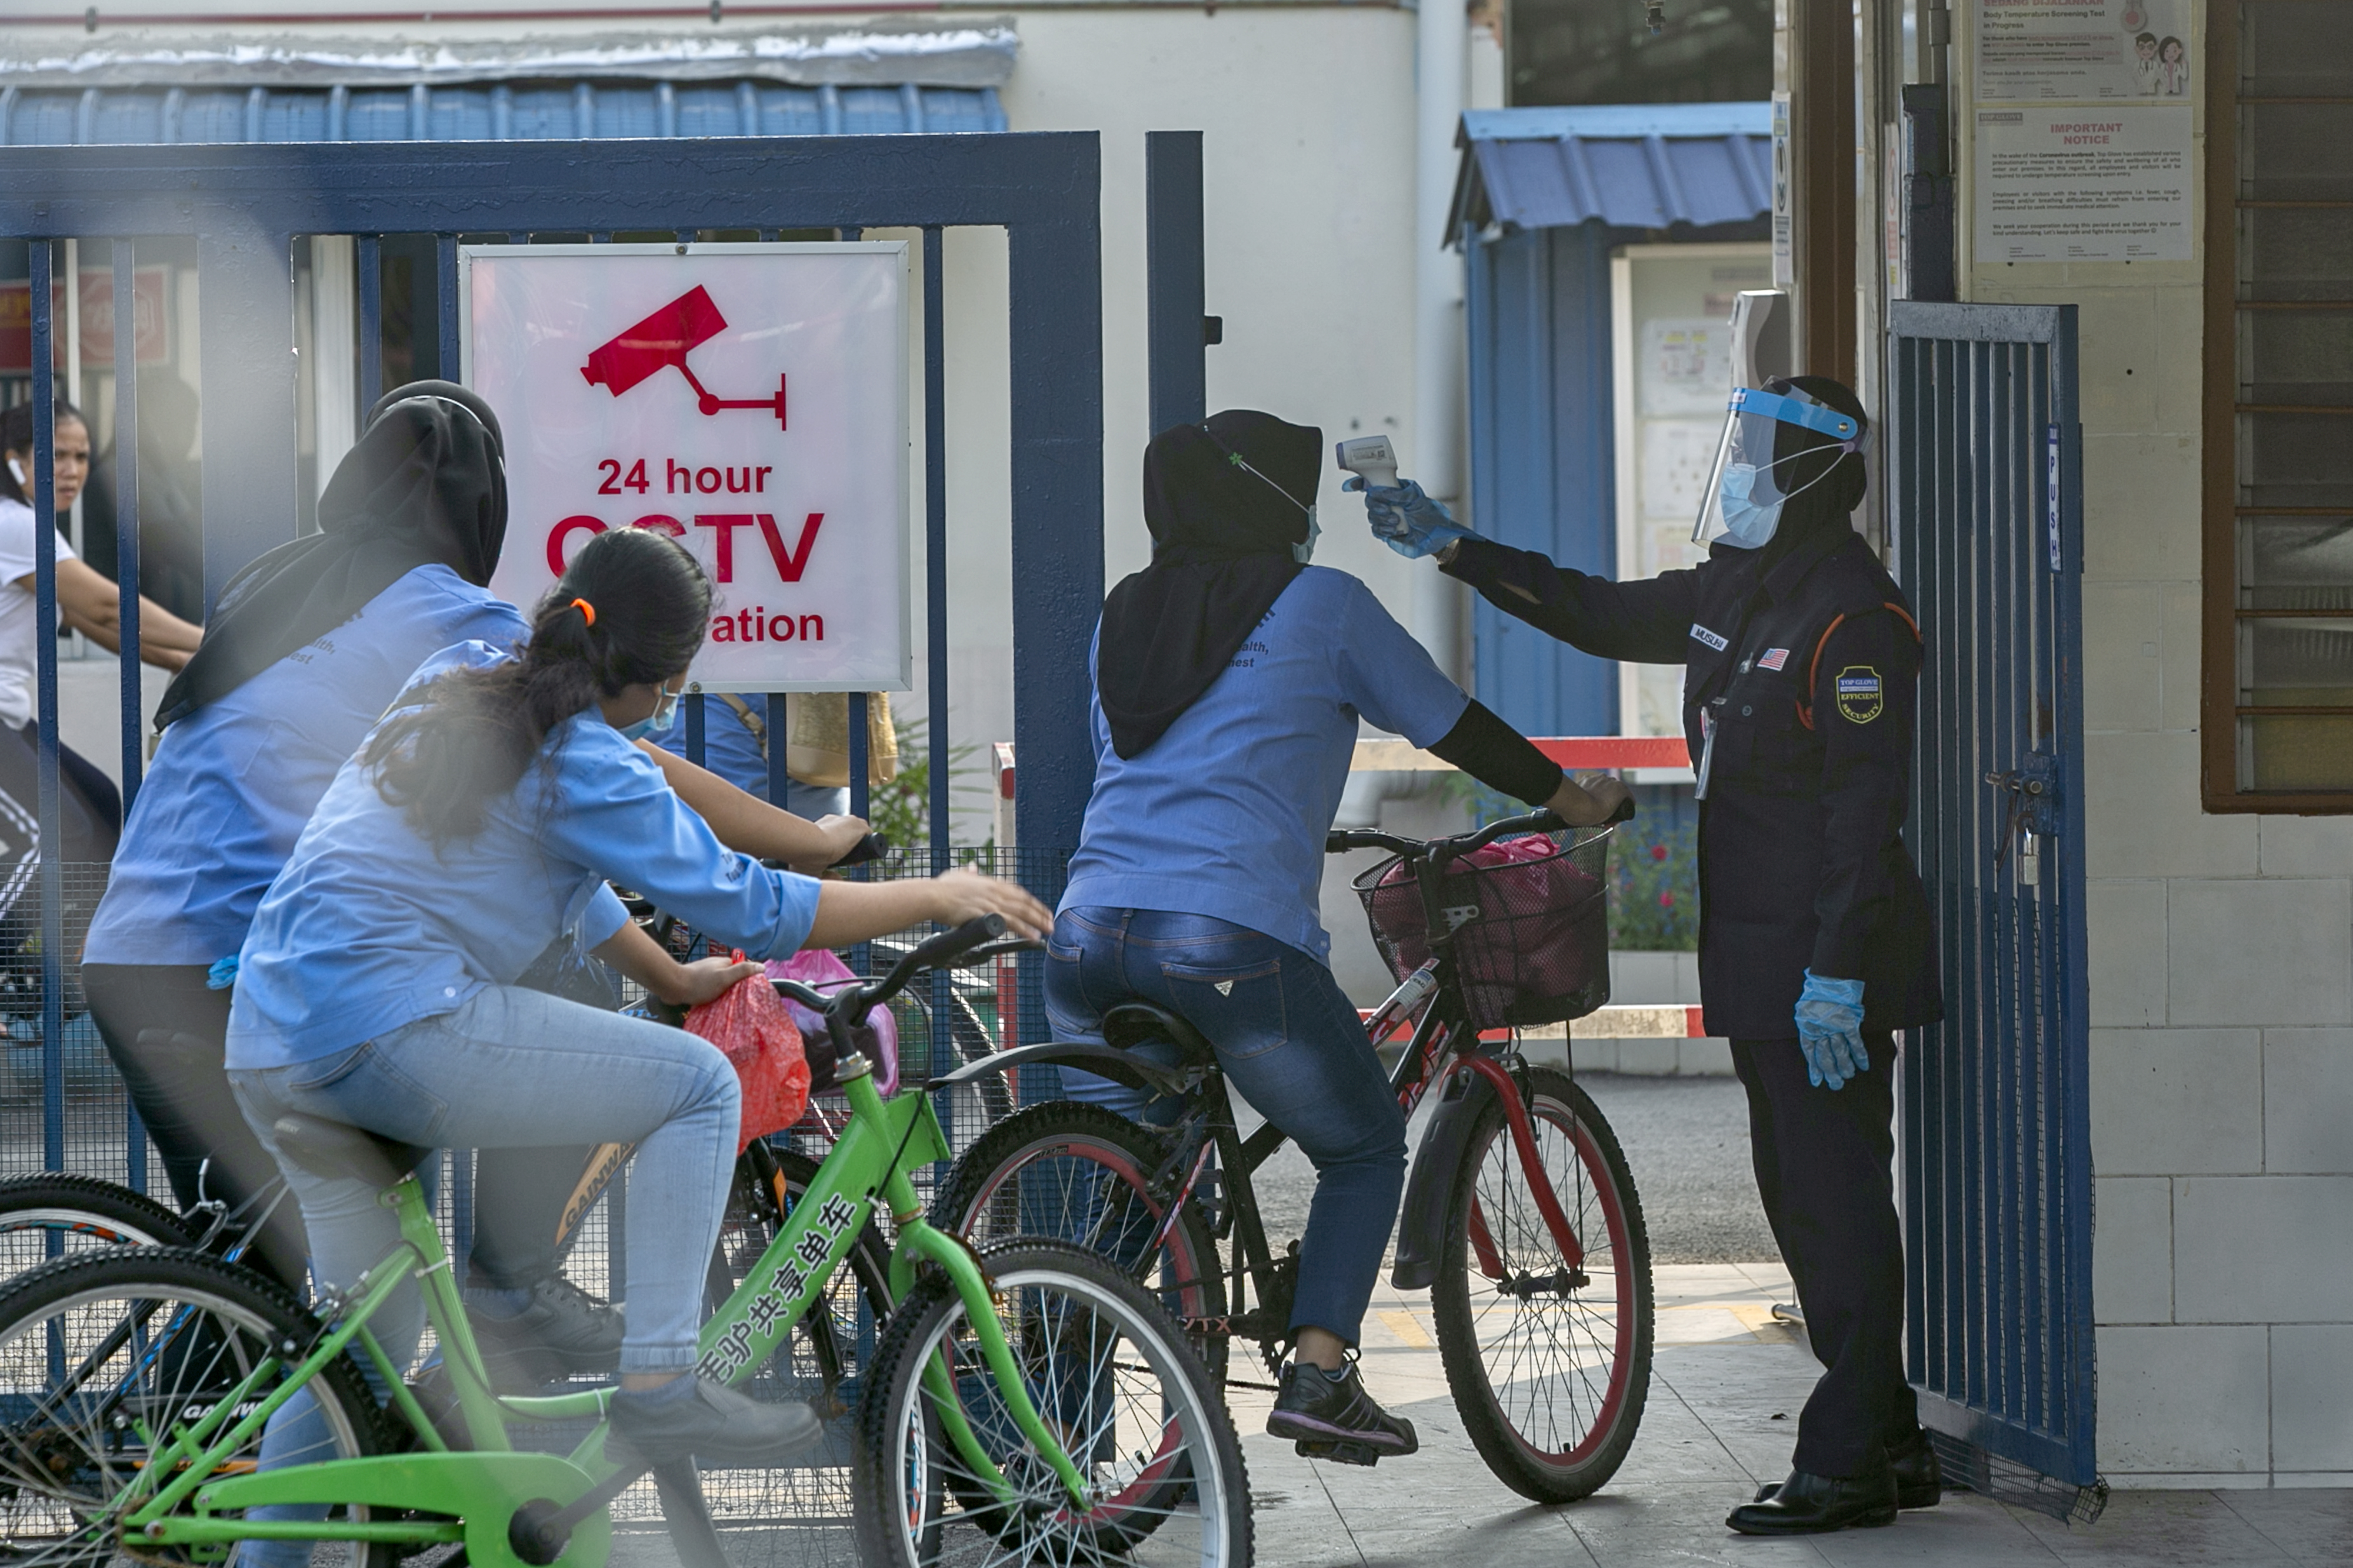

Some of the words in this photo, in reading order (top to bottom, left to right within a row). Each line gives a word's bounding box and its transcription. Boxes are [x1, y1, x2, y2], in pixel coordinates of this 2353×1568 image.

[2050, 123, 2122, 133] IMPORTANT
[2064, 135, 2109, 145] NOTICE
[597, 459, 650, 495] 24
[666, 458, 772, 493] hour
[711, 606, 825, 642] ation
[1842, 703, 1879, 719] SECURITY
